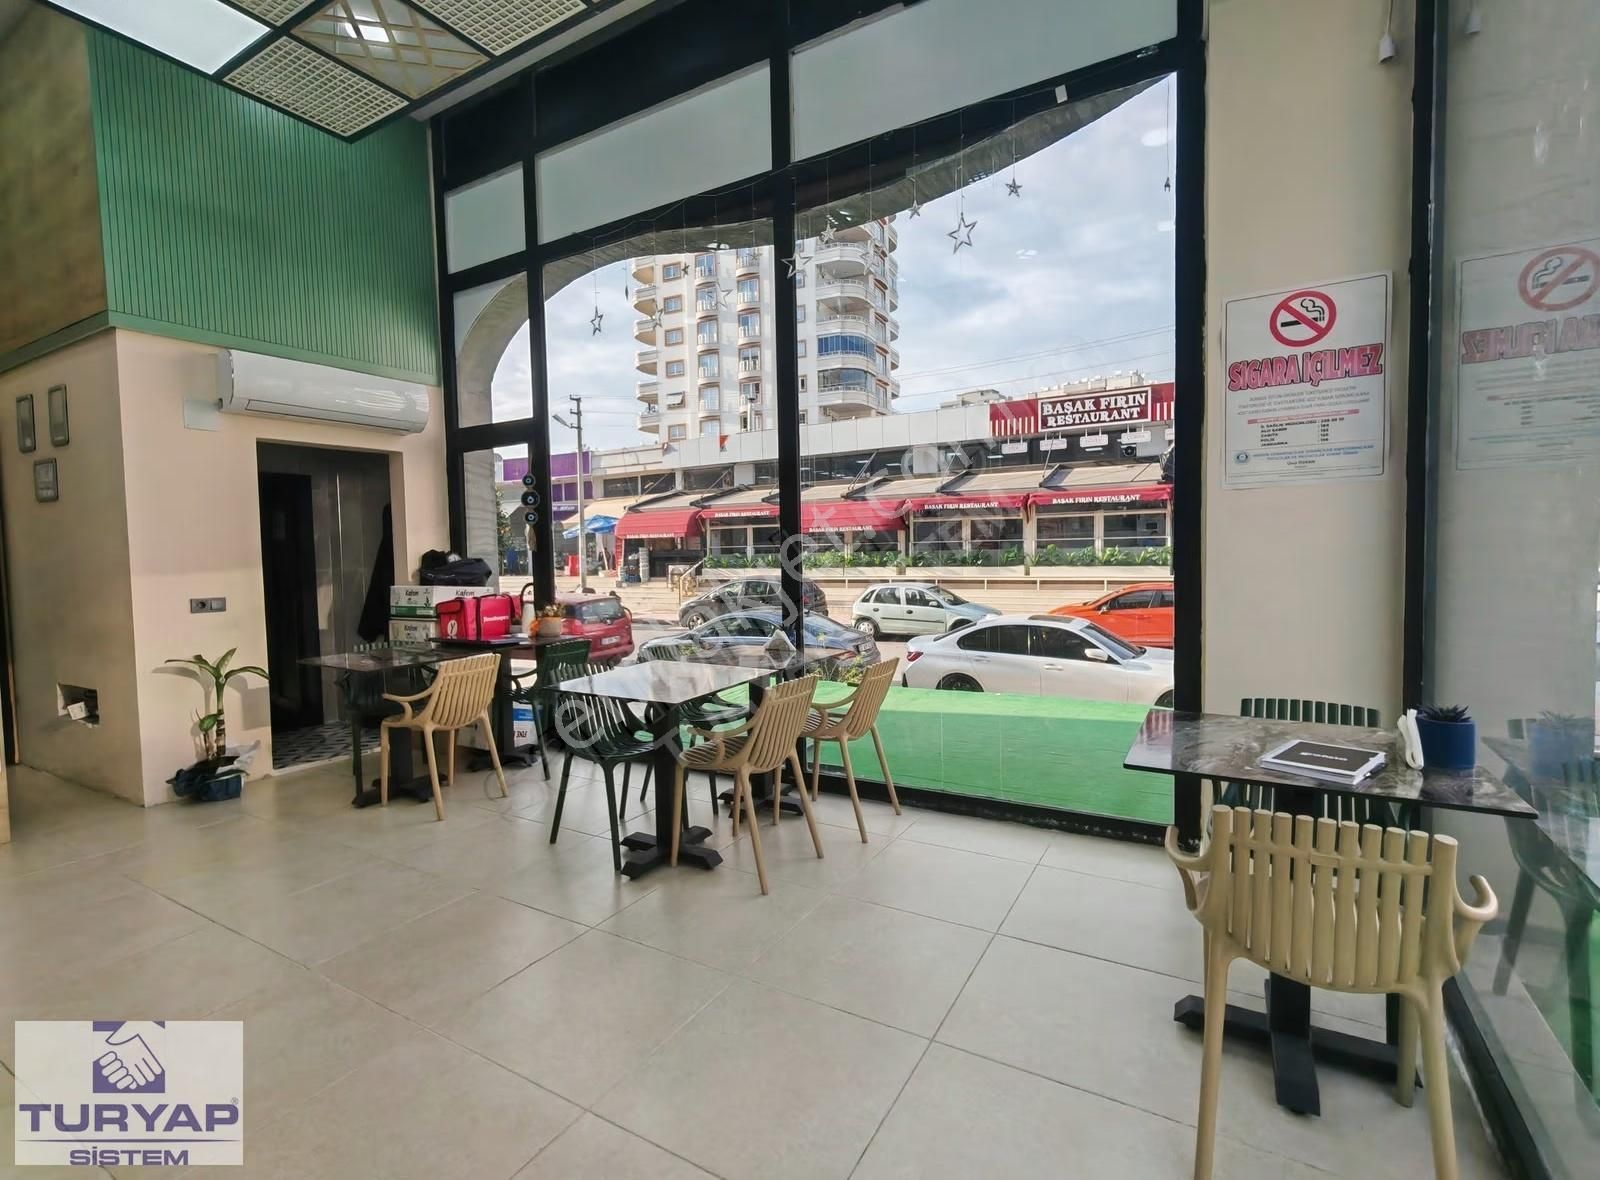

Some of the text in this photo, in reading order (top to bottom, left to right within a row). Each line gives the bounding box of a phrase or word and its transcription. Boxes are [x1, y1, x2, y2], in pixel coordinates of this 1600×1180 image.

[1042, 393, 1147, 416] BAŞAK FIRIN
[1046, 407, 1141, 427] RESTAURANT
[1094, 494, 1140, 503] RESTAURANT
